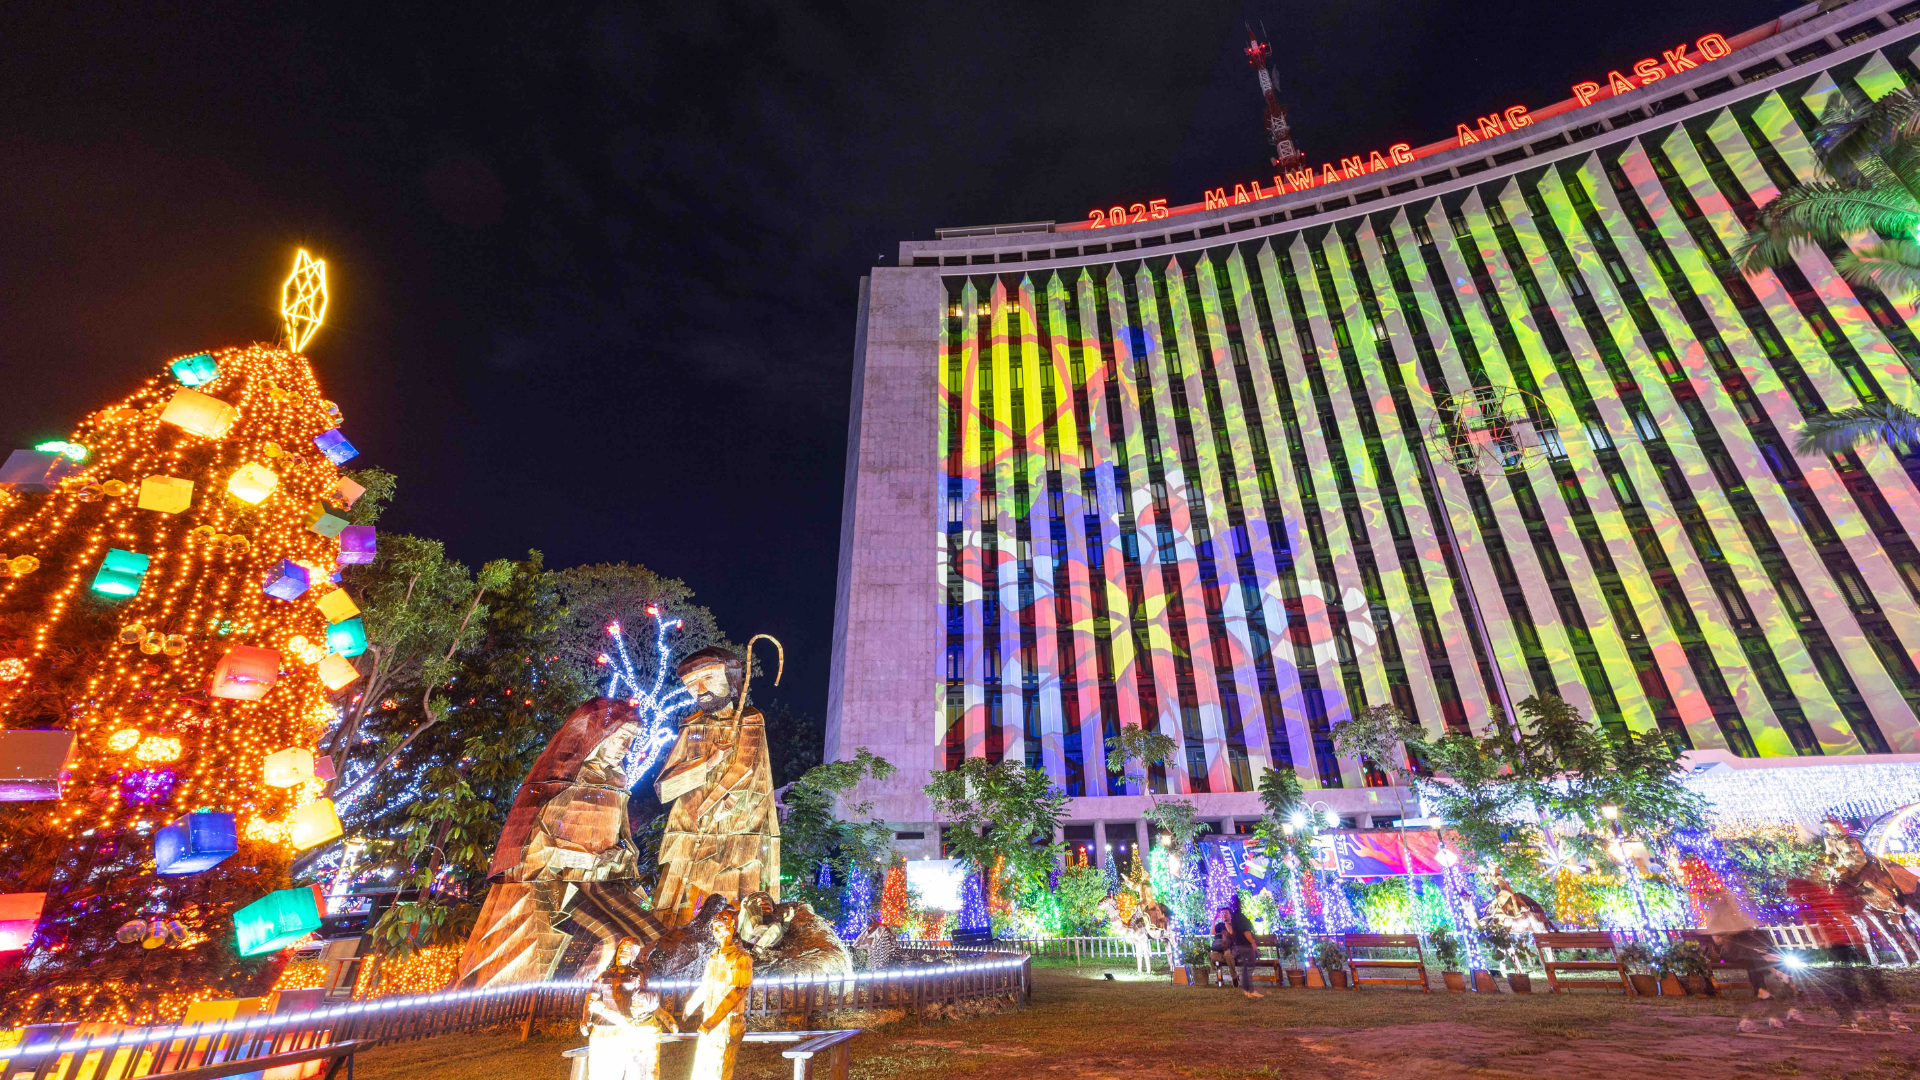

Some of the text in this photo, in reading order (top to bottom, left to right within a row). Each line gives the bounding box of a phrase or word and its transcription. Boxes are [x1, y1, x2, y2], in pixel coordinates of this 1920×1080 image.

[1088, 32, 1732, 230] 2025 MALIWANAG ANG PASKO
